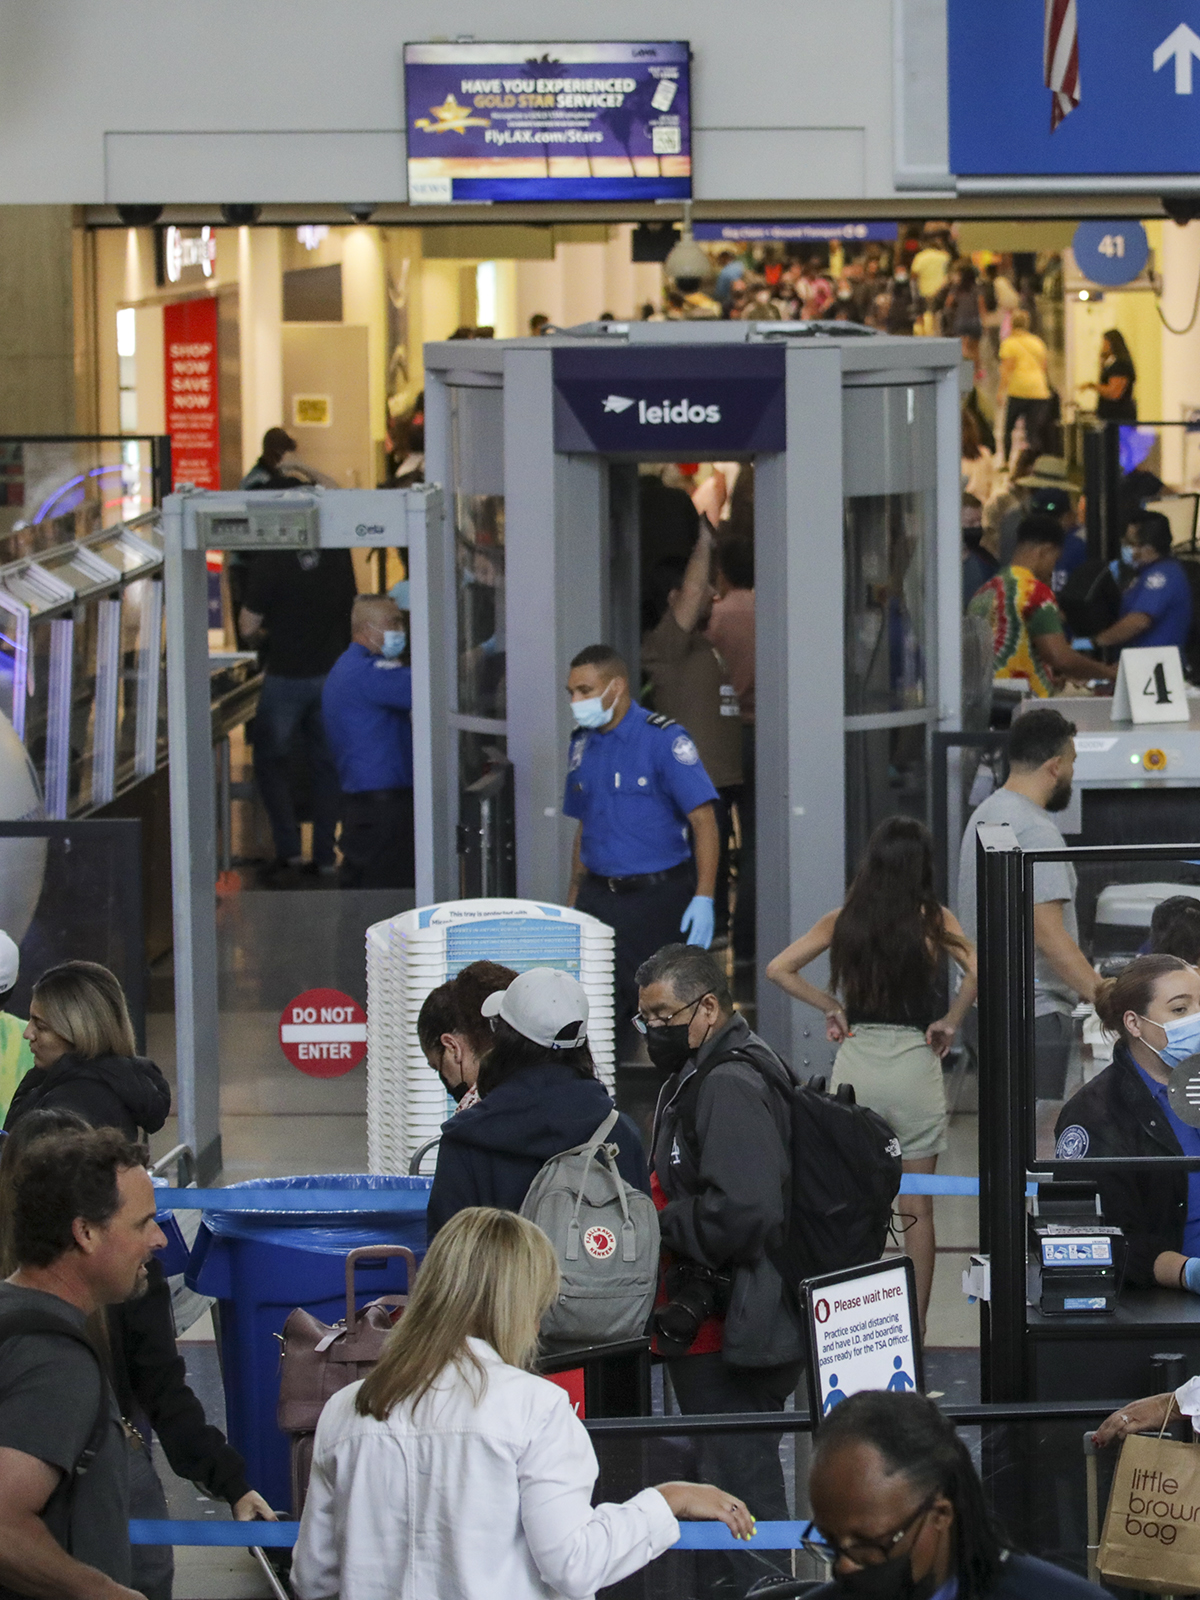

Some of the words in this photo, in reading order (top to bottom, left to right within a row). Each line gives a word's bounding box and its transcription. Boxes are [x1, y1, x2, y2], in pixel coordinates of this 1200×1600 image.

[461, 79, 499, 93] HAVE
[503, 79, 535, 93] YOU
[537, 78, 636, 93] EXPERIENCED
[474, 95, 516, 109] GOLD
[517, 95, 555, 109] STAR
[556, 94, 624, 108] SERVICE?
[484, 129, 604, 146] FlyLAX.com/Stars
[1098, 233, 1125, 258] 41
[170, 343, 212, 358] SHOP
[172, 361, 211, 375] NOW
[171, 377, 212, 392] SAVE
[172, 394, 211, 409] NOW
[638, 398, 721, 425] leidos
[1143, 662, 1173, 705] 4
[463, 911, 476, 919] tray
[292, 1007, 317, 1023] DO
[320, 1006, 354, 1023] NOT
[298, 1043, 352, 1059] ENTER
[834, 1296, 861, 1313] Please
[862, 1290, 881, 1305] wait
[882, 1286, 903, 1299] here.
[824, 1327, 849, 1341] Practice
[849, 1320, 867, 1334] social
[868, 1313, 900, 1328] distancing
[822, 1342, 835, 1353] and
[835, 1338, 851, 1351] have
[852, 1335, 862, 1346] I.D.
[863, 1331, 874, 1342] and
[875, 1324, 903, 1337] boarding
[820, 1355, 833, 1367] pass
[834, 1350, 853, 1362] ready
[853, 1346, 863, 1356] for
[863, 1342, 875, 1353] the
[875, 1339, 888, 1350] TSA
[888, 1334, 910, 1346] Officer.
[1131, 1468, 1179, 1495] little
[1125, 1513, 1177, 1545] bag
